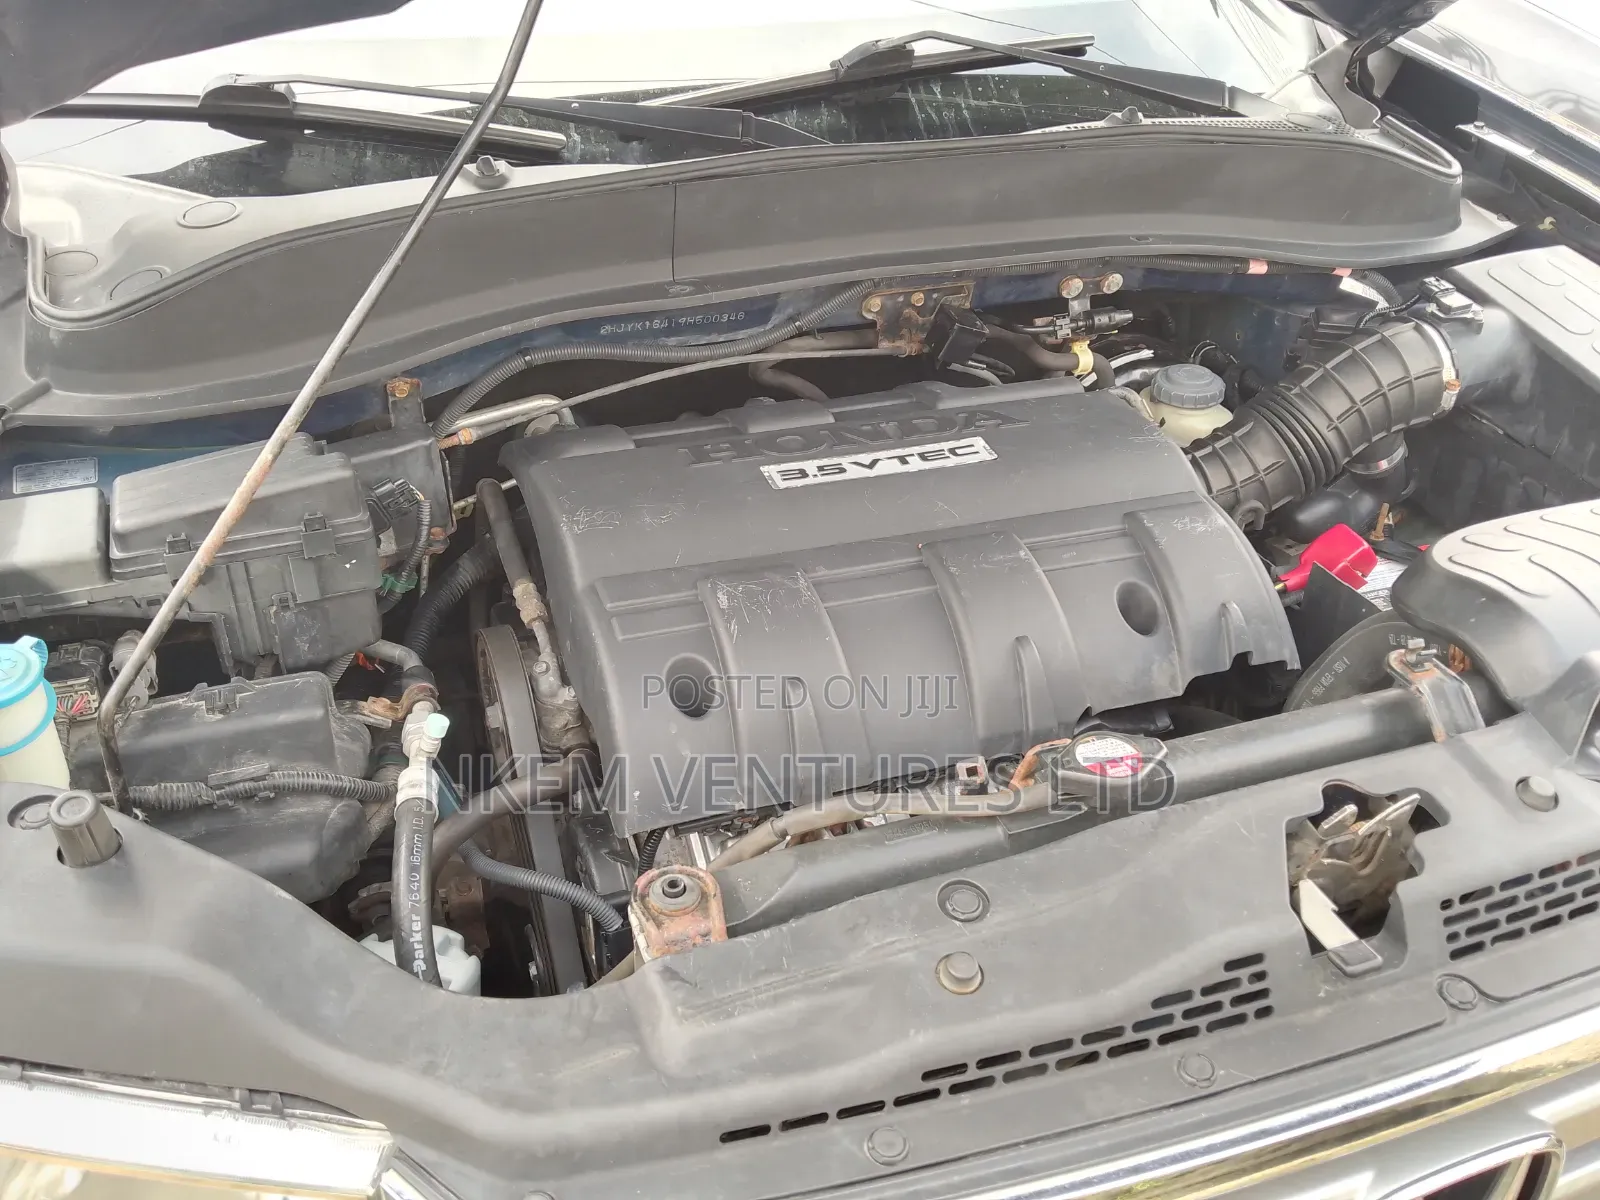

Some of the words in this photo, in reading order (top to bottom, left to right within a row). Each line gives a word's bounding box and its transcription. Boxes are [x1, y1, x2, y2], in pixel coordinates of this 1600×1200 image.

[678, 410, 1031, 467] HONDA
[410, 834, 423, 866] 16mm
[408, 873, 421, 909] 7640
[409, 913, 427, 980] Parker
